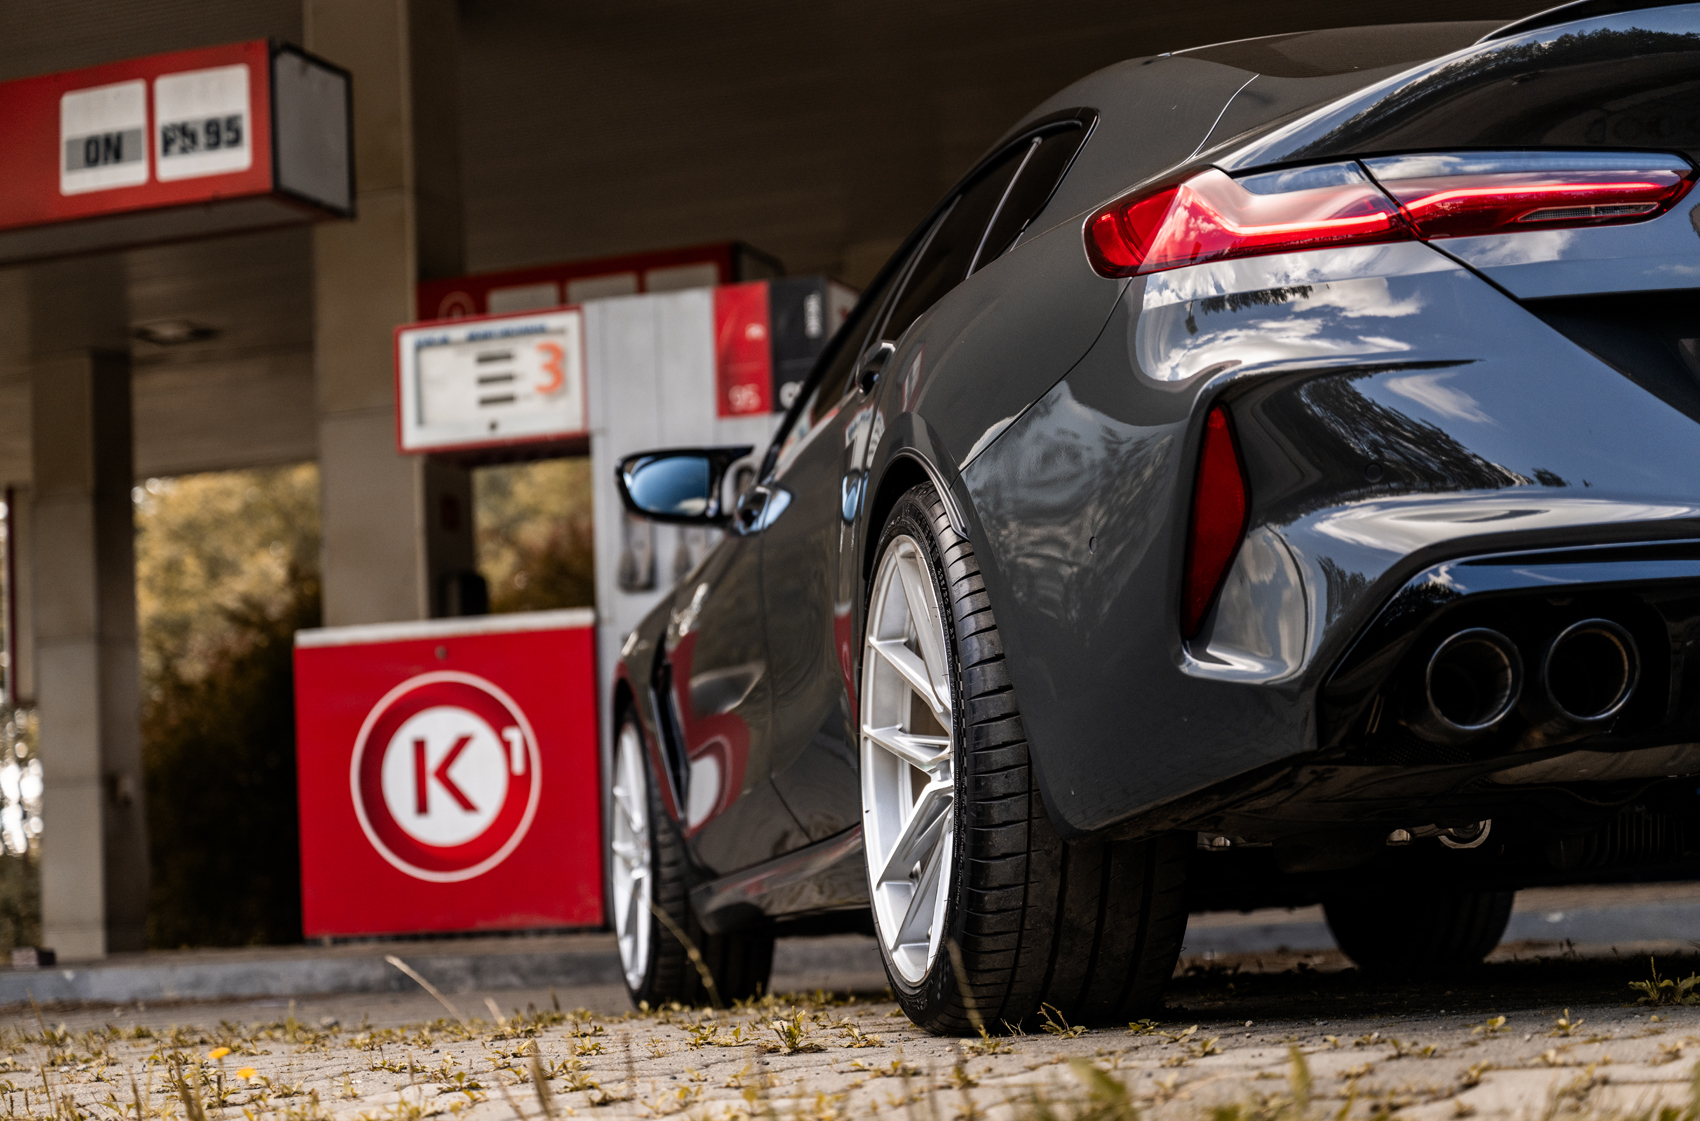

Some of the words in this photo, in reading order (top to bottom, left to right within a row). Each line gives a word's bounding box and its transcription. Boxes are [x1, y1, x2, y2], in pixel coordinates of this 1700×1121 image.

[84, 131, 123, 168] ON
[203, 113, 243, 151] 95
[535, 342, 565, 395] 3
